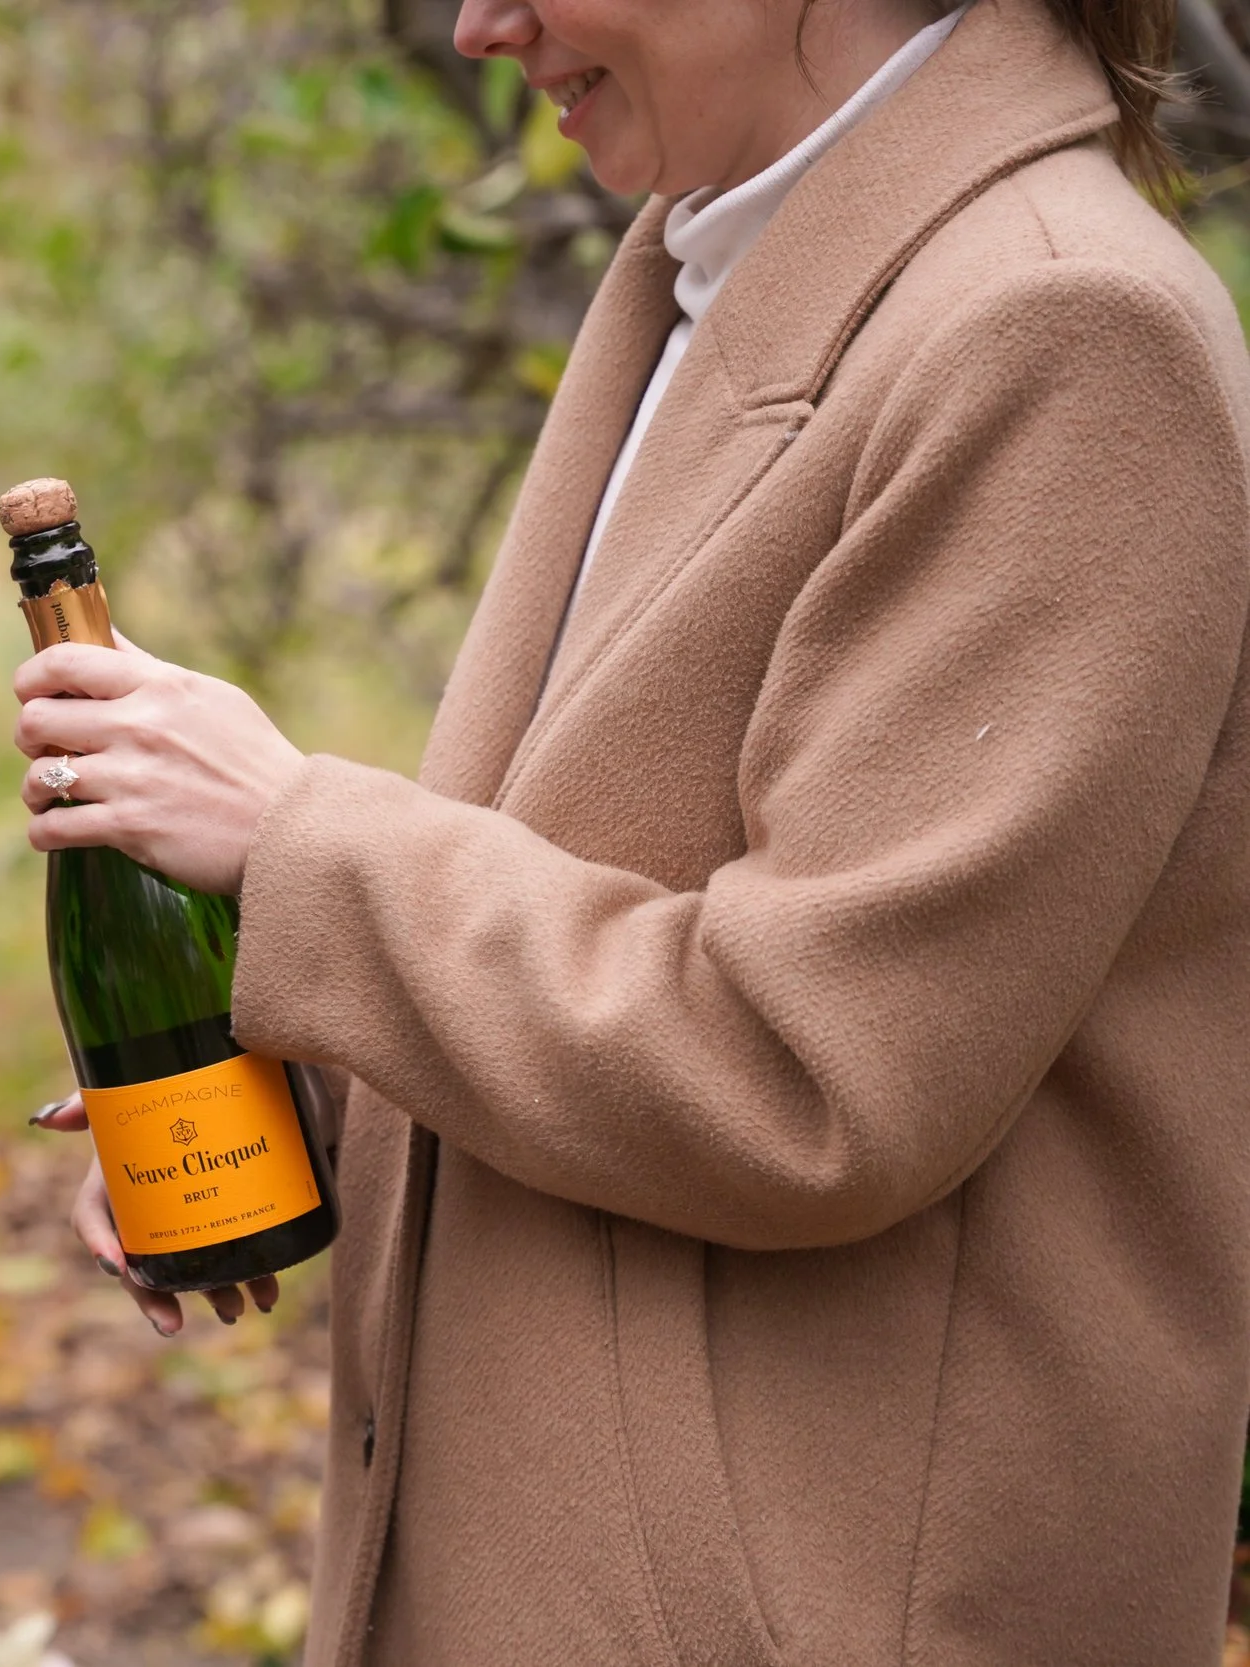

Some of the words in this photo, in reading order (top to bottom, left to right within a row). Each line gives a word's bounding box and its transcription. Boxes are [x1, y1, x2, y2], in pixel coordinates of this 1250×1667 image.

[116, 1084, 243, 1126] CHAMPAGNE
[122, 1163, 178, 1186] Veuve
[182, 1135, 270, 1176] Clicquot
[183, 1186, 220, 1204] BRUT
[149, 1228, 178, 1240] DEPUIS
[180, 1224, 201, 1235] 1772
[210, 1215, 239, 1229] REIMS
[241, 1203, 276, 1221] FRANCE
